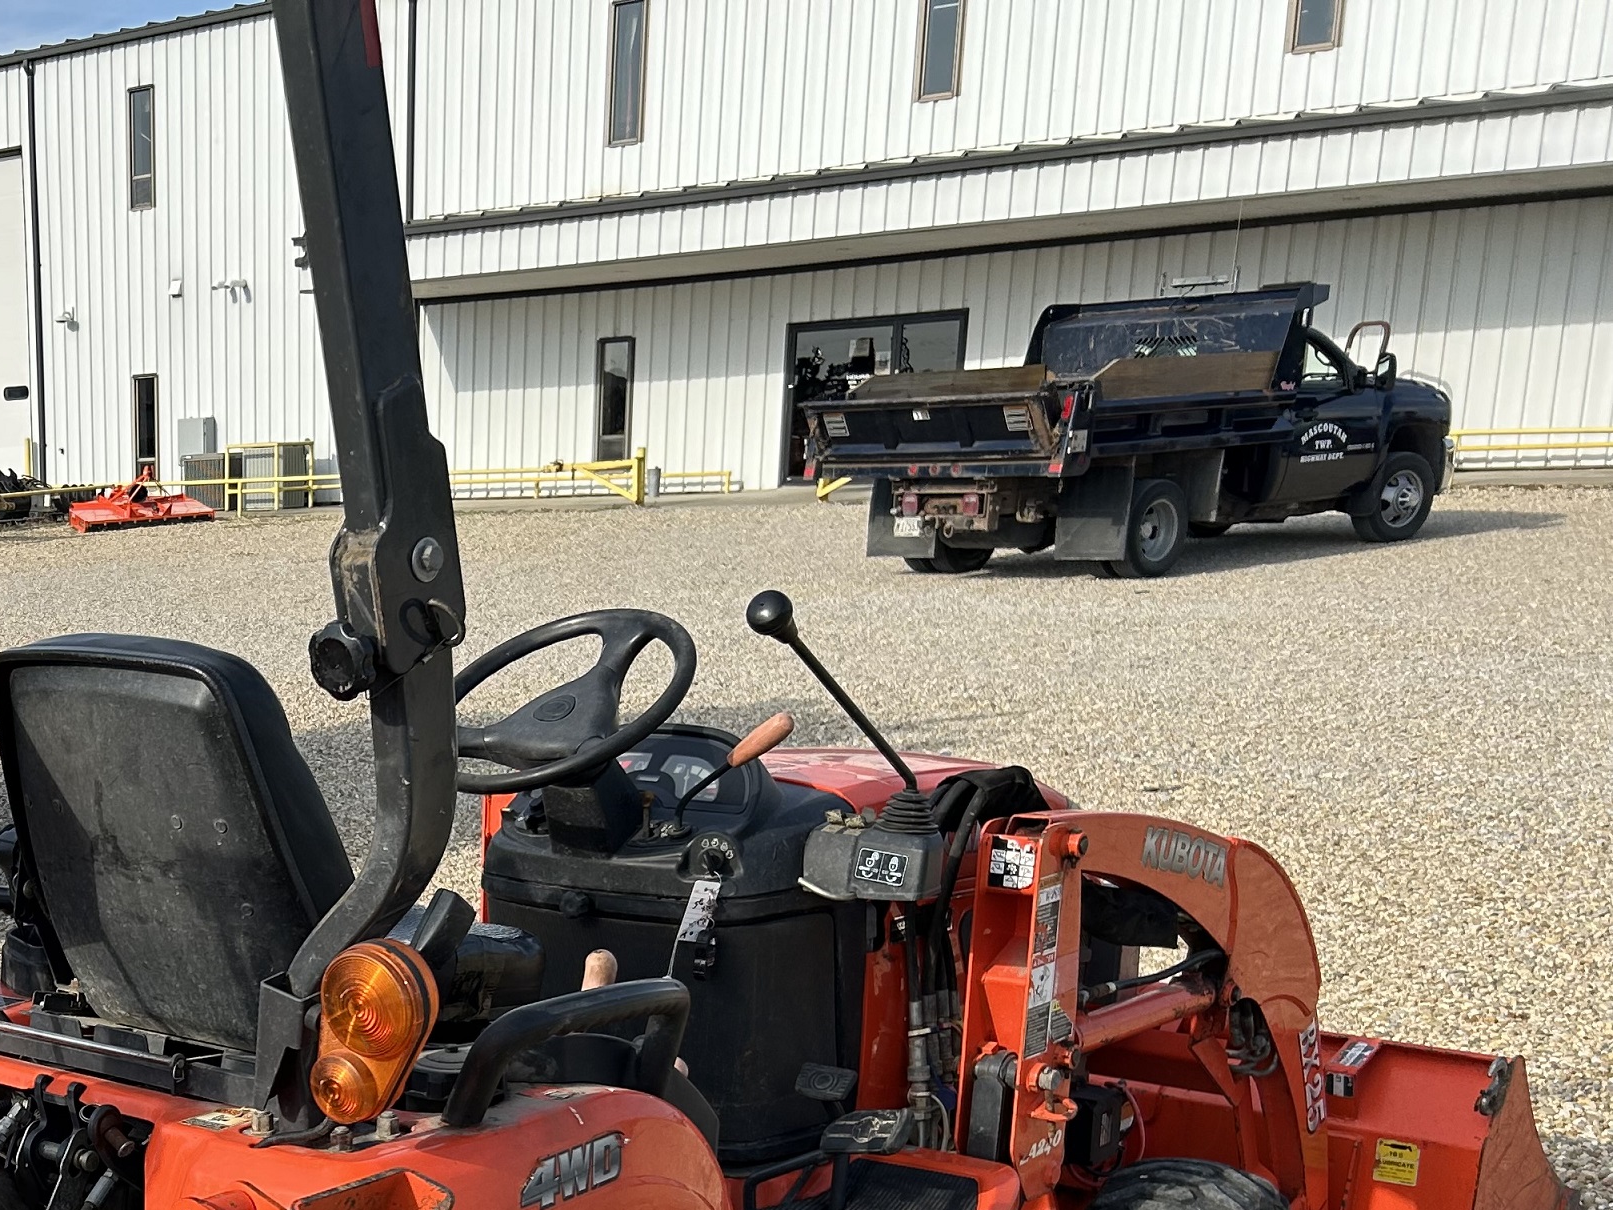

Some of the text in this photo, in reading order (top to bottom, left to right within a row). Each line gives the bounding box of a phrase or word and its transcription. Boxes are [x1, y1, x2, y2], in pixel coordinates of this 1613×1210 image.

[1300, 422, 1347, 446] MASCOUTAH
[1141, 825, 1227, 890] KUBOTA
[1298, 1018, 1326, 1134] BX25
[520, 1130, 623, 1210] 4WD
